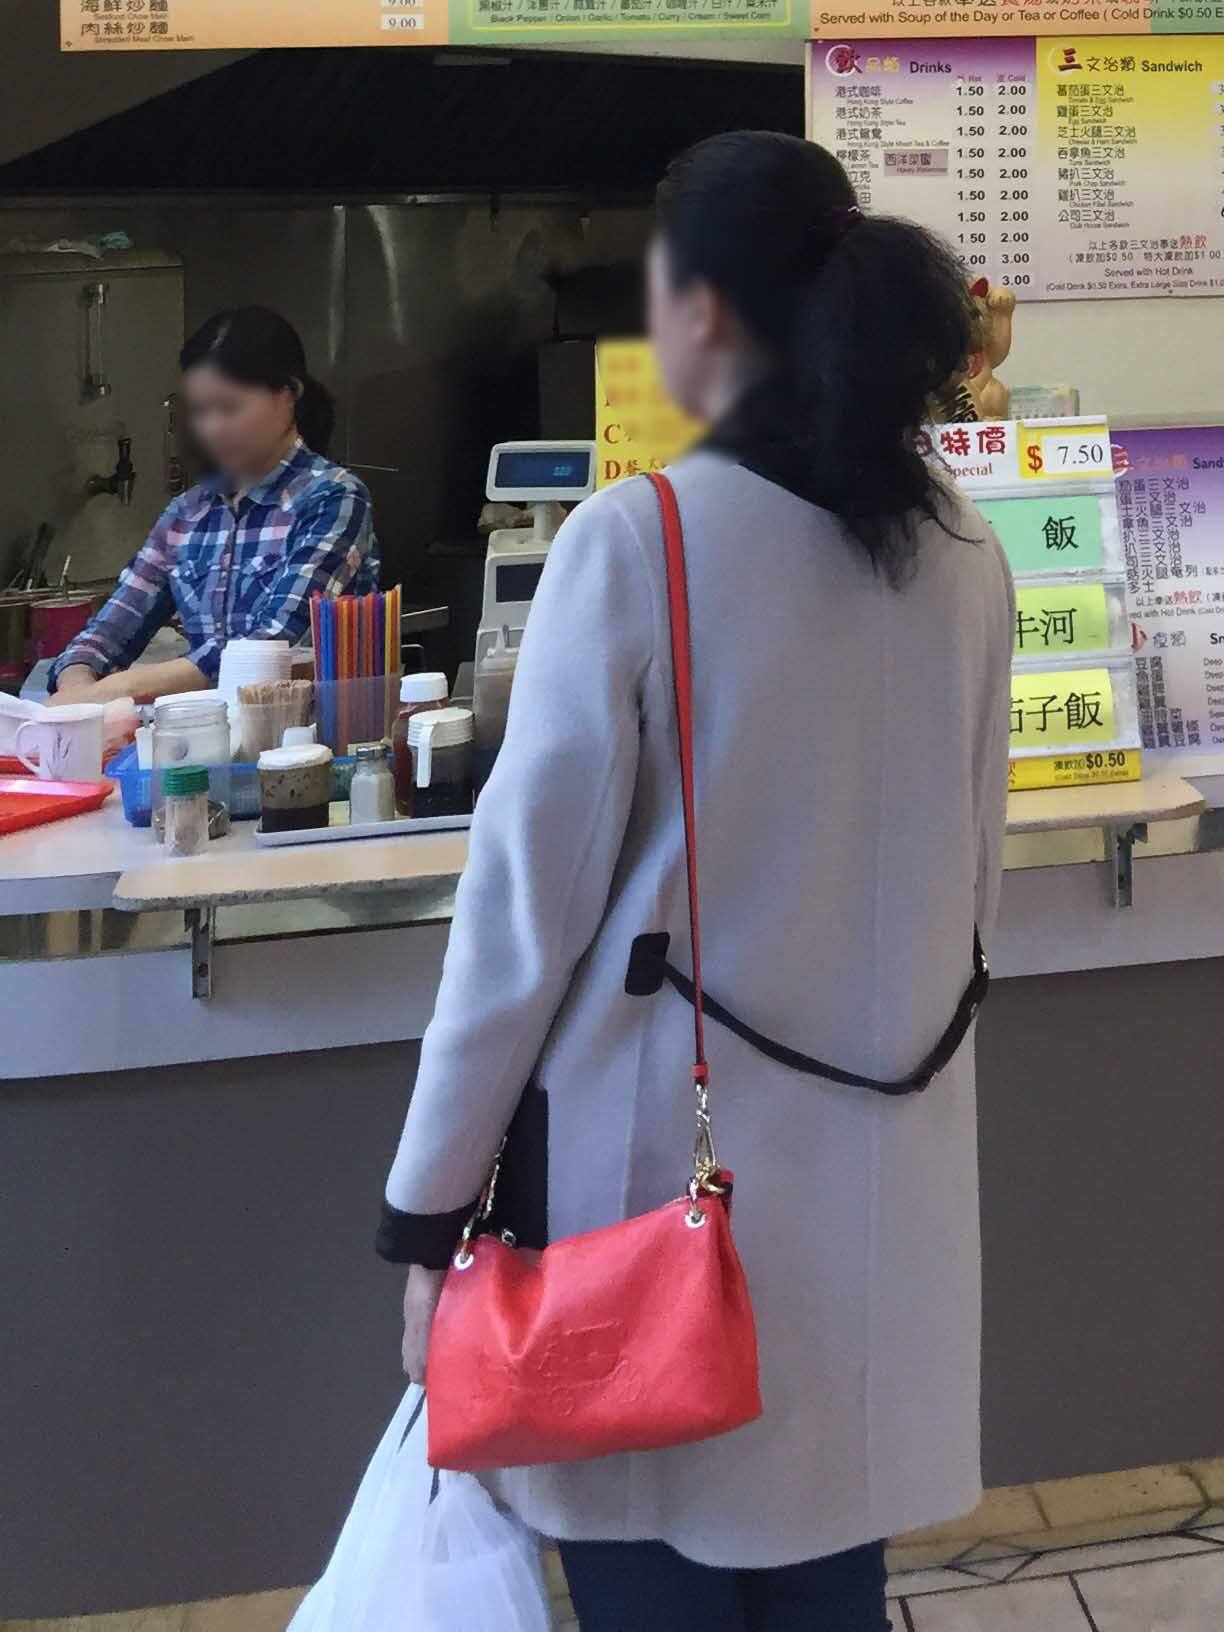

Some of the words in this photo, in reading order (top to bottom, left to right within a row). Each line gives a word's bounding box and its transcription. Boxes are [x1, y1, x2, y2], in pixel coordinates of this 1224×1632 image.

[821, 10, 865, 25] Served
[869, 10, 894, 23] with
[898, 9, 932, 26] Soup
[935, 9, 946, 22] of
[950, 9, 969, 22] the
[973, 8, 998, 25] Day
[1002, 10, 1015, 22] or
[1019, 8, 1040, 22] Tea
[1060, 7, 1100, 22] Coffee
[1143, 6, 1176, 19] Drink
[909, 60, 951, 74] Drinks
[1141, 59, 1203, 73] Sandwich
[956, 85, 984, 97] 1.50
[998, 84, 1026, 96] 2.00
[956, 105, 984, 116] 1.50
[998, 104, 1026, 115] 2.00
[957, 210, 985, 222] 1.50
[1000, 210, 1029, 221] 2.00
[1002, 252, 1030, 264] 3.00
[1002, 273, 1030, 285] 3.00
[940, 427, 1005, 456] 特價
[1027, 445, 1043, 473] $
[1058, 443, 1103, 465] 7.50
[1042, 516, 1078, 550] 飯
